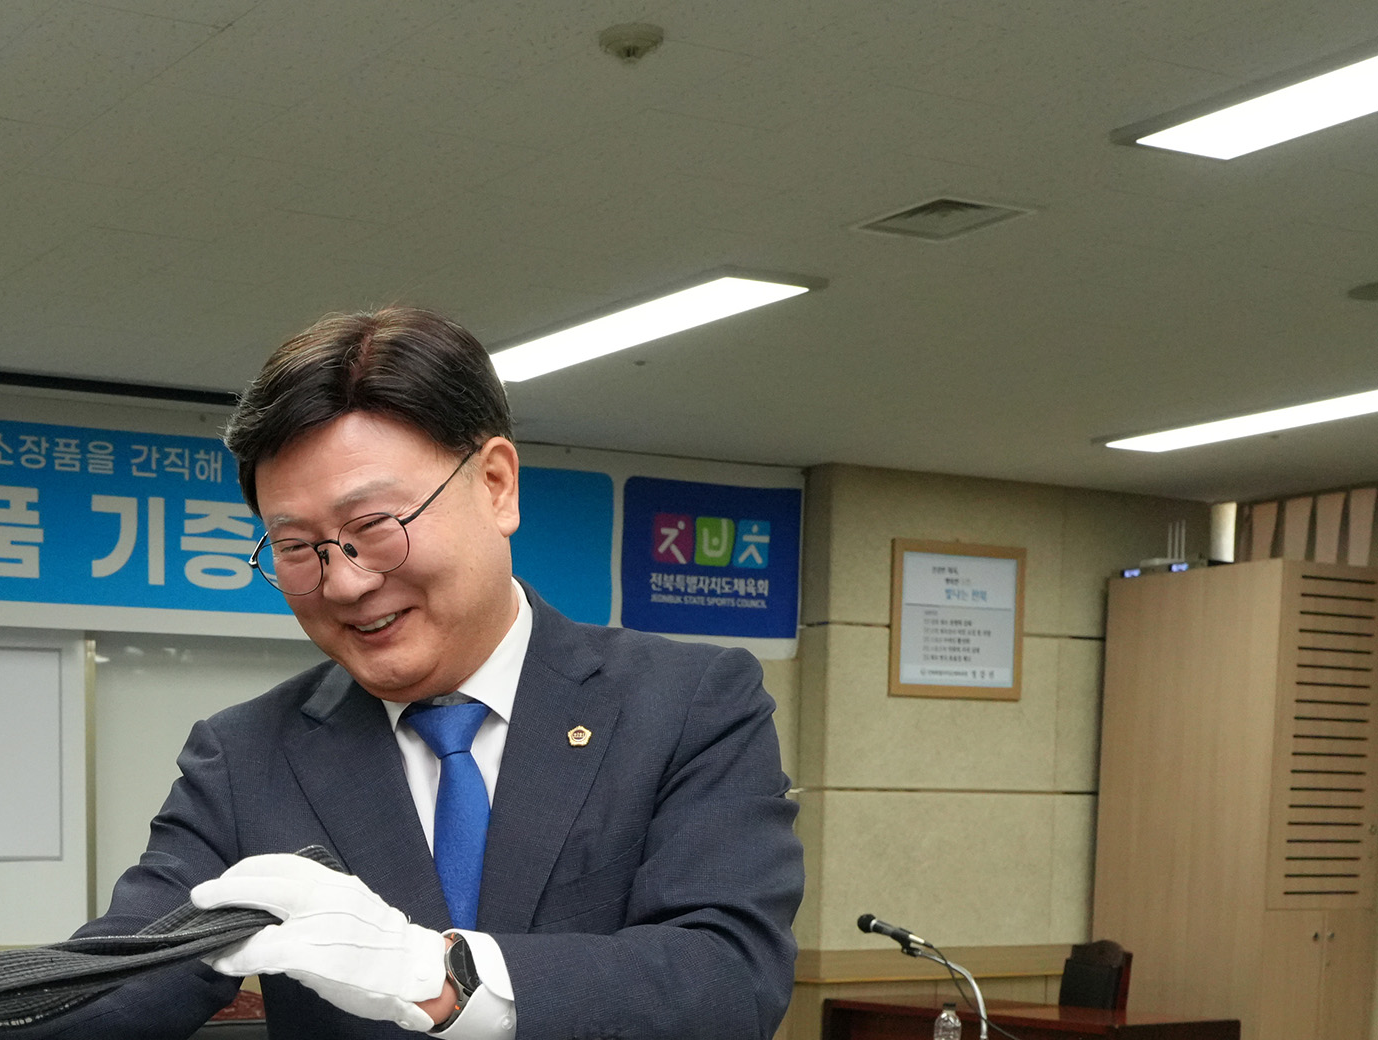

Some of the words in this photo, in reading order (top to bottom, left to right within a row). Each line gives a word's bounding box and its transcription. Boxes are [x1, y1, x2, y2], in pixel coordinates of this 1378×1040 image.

[130, 444, 222, 482] 간직해
[91, 494, 279, 590] 기증
[650, 573, 769, 596] 전북특별자치도체육회
